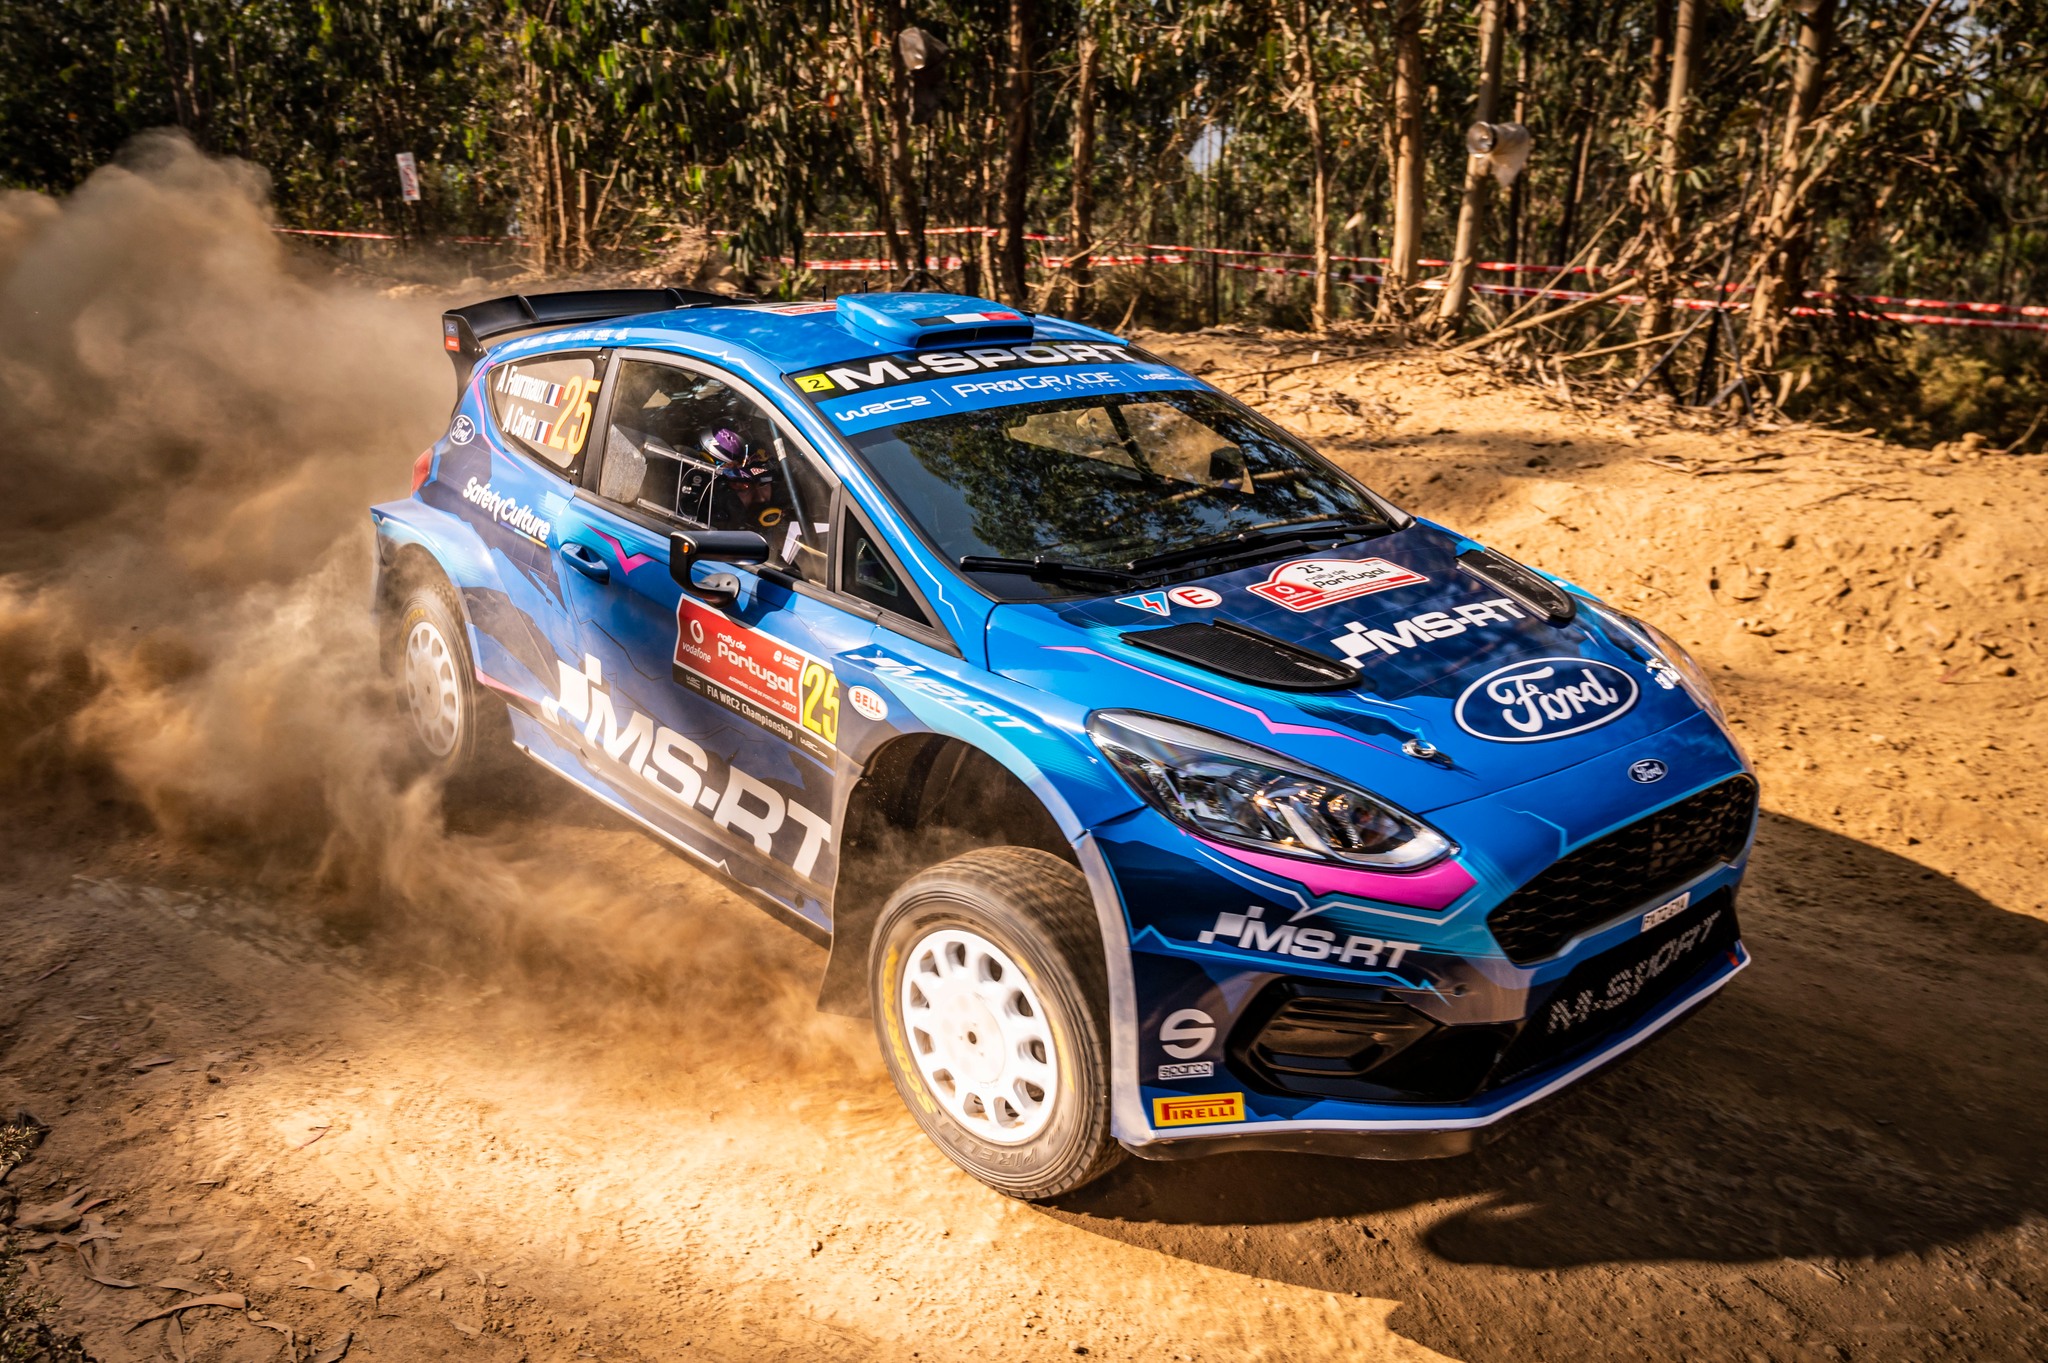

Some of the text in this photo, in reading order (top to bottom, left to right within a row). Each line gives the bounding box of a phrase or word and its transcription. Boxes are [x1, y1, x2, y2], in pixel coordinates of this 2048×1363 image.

[807, 344, 1135, 391] 2 M-SPORT
[496, 364, 549, 404] A Fourmaux
[1053, 382, 1127, 392] DIGITAL
[502, 403, 537, 441] A Coria
[547, 375, 602, 455] 25
[834, 395, 932, 422] WRC2
[451, 416, 473, 442] Ford
[462, 476, 551, 541] SafetyCulture
[1296, 564, 1324, 574] 25
[1312, 568, 1392, 589] Portugal
[1176, 589, 1214, 605] E
[1362, 598, 1527, 655] MS-RT
[682, 641, 712, 664] vodafone
[735, 640, 747, 652] de
[717, 641, 798, 698] Portugal
[707, 684, 720, 700] FIA
[719, 690, 741, 712] WRC2
[741, 702, 794, 741] Championship
[781, 699, 798, 714] 2023
[803, 663, 840, 745] 25
[854, 690, 881, 714] BELL
[1486, 666, 1620, 733] Ford
[583, 686, 832, 884] MS-RT
[1633, 761, 1667, 782] Ford
[1237, 919, 1422, 969] MS-RT
[1160, 1063, 1211, 1079] sparco
[1161, 1098, 1236, 1121] PIRELLI
